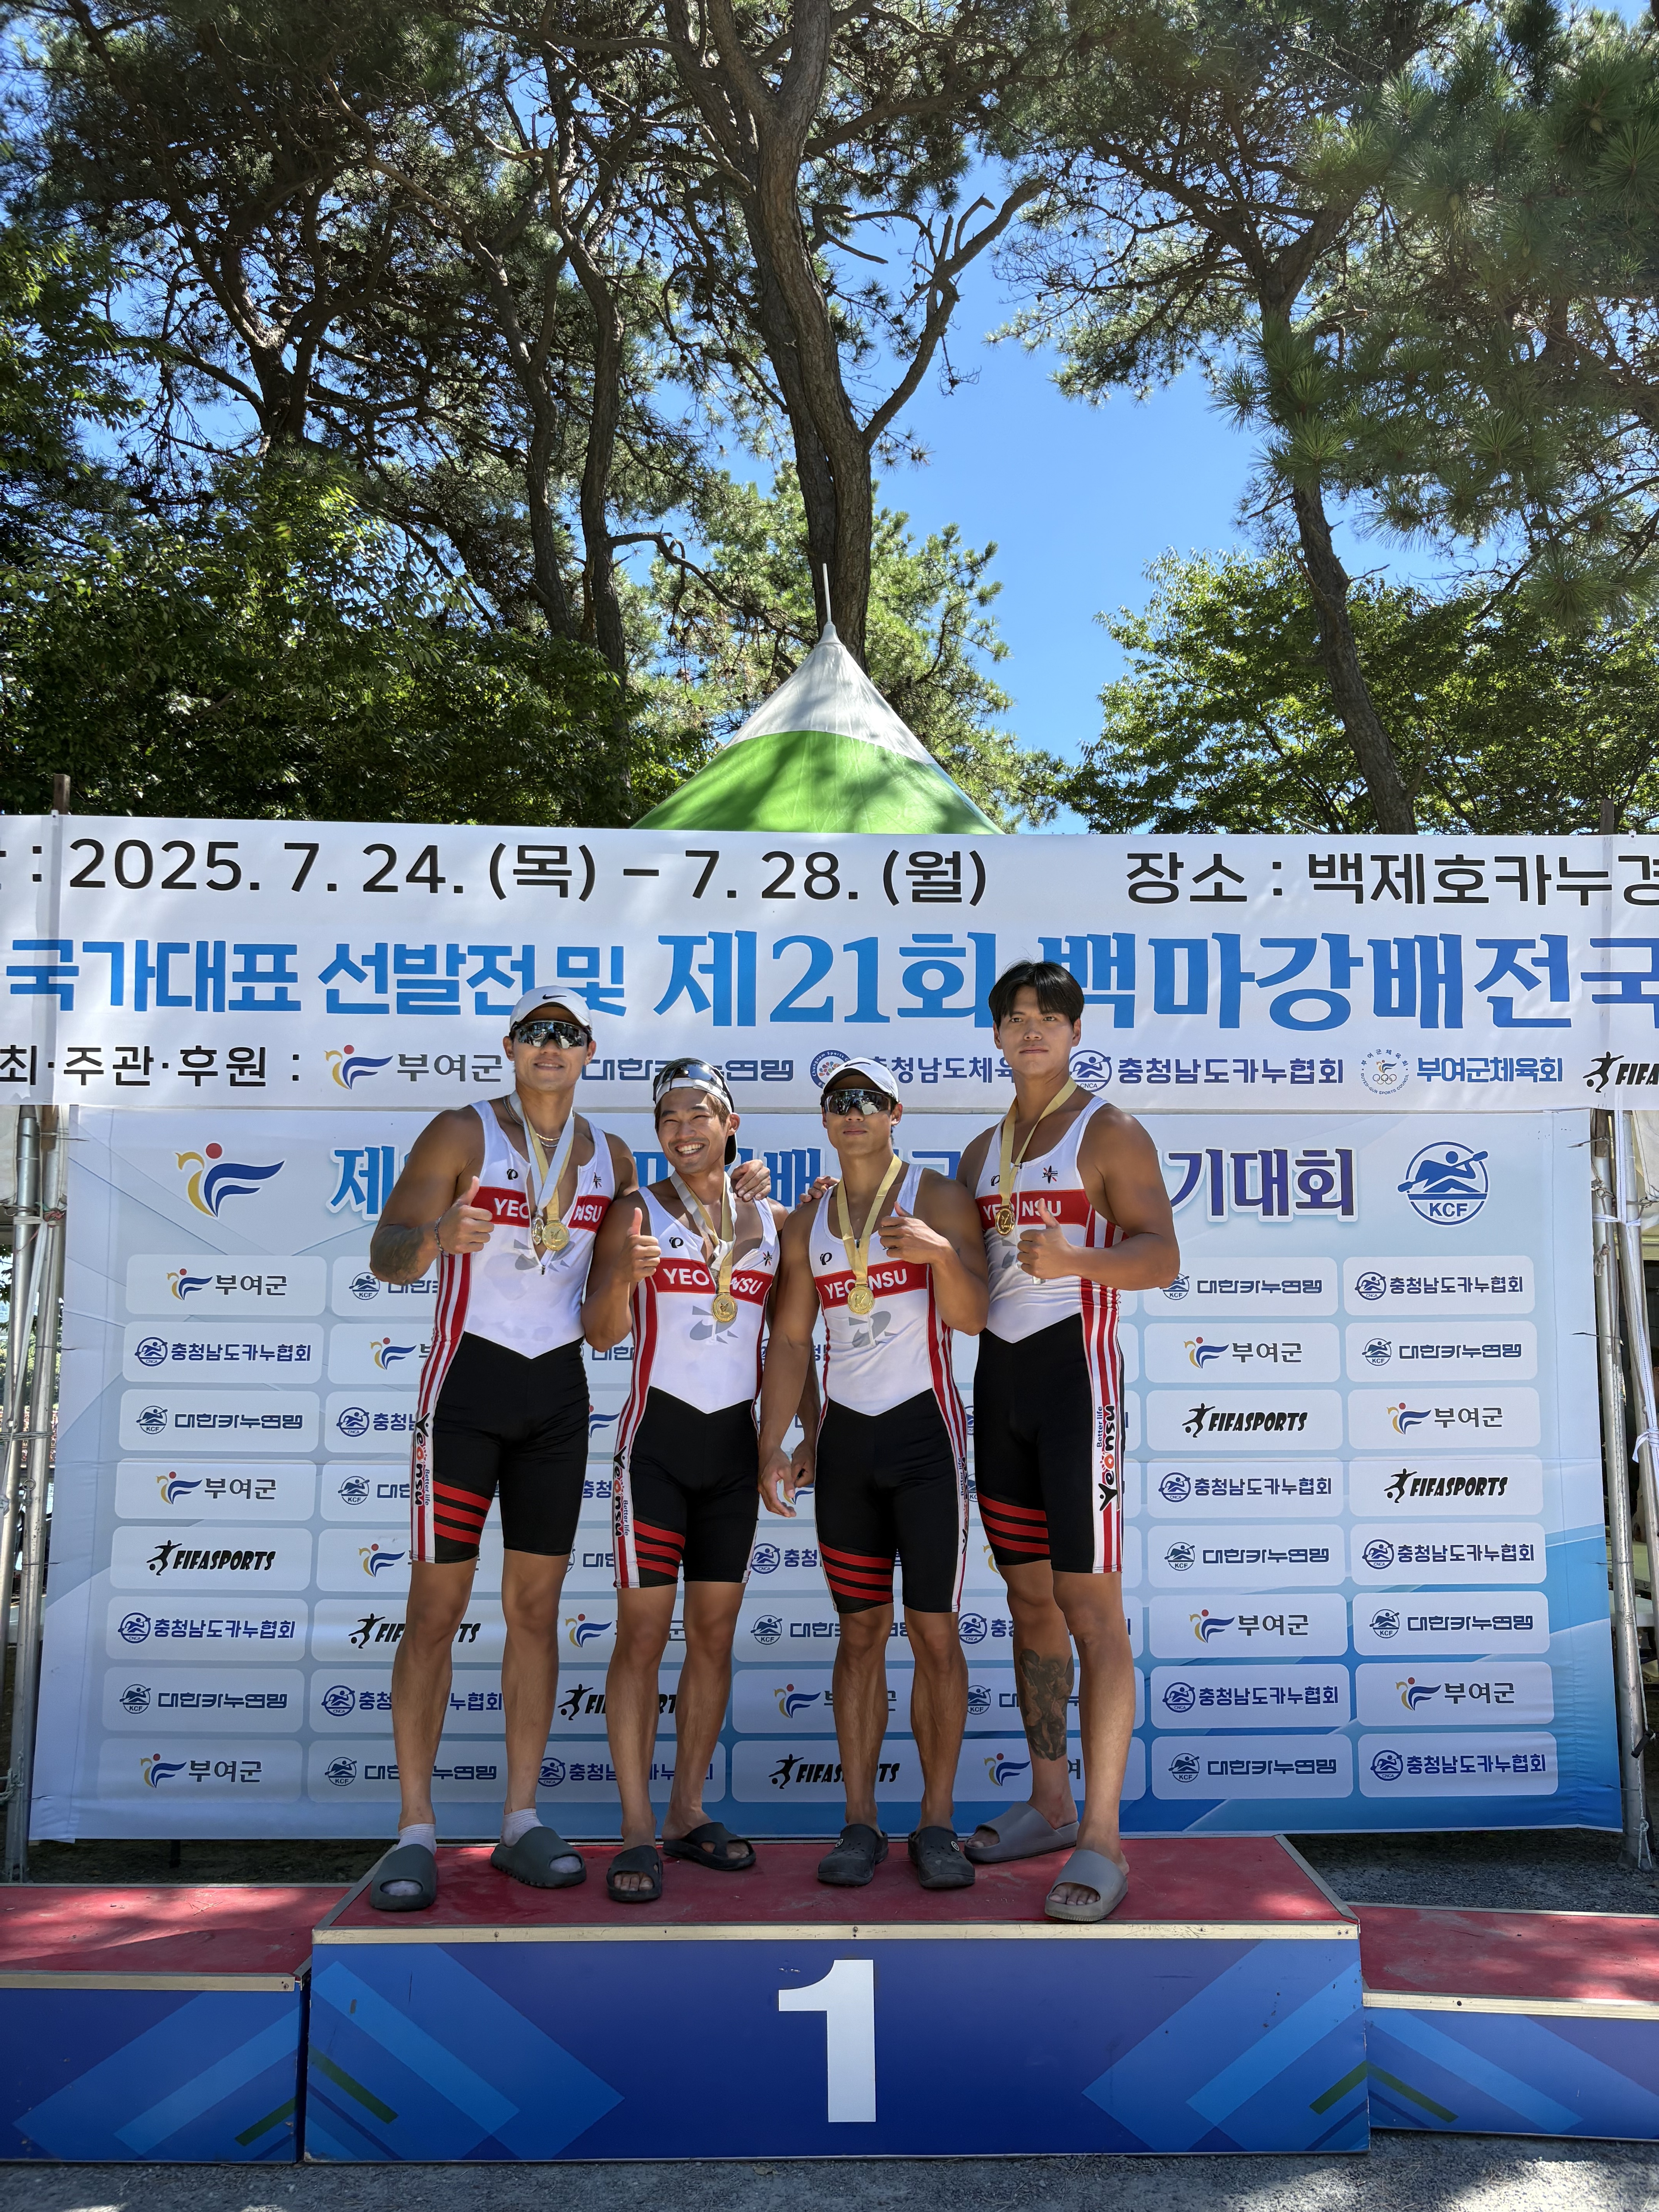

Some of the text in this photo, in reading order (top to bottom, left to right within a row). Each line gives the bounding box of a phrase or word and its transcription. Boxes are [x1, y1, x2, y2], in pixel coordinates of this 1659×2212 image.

[70, 838, 259, 891] 2025.
[284, 842, 337, 892] 7.
[363, 843, 463, 893] 24.
[489, 843, 595, 902] (목)
[685, 850, 737, 899] 7.
[762, 851, 858, 900] 28.
[883, 849, 986, 907] (월)
[1127, 852, 1247, 904] 장소
[6, 939, 301, 1012] 국가대표
[318, 943, 535, 1016] 선발전
[556, 946, 626, 1017] 및
[654, 930, 997, 1029] 제21회
[397, 1054, 503, 1082] 부여군
[1118, 1058, 1343, 1084] 충청남도카누협회
[1417, 1056, 1563, 1083] 부여군체육회
[1429, 1203, 1468, 1217] KCF
[215, 1275, 287, 1296] 부여군
[1197, 1279, 1322, 1294] 대한카누연맹
[1389, 1276, 1523, 1294] 충청남도카누협회
[171, 1343, 311, 1362] 충청남도카누협회
[1232, 1343, 1302, 1363] 부여군
[1399, 1344, 1522, 1359] 대한카누연맹
[175, 1413, 303, 1429] 대한카누연맹
[1208, 1412, 1308, 1432] FIFASPORTS
[1434, 1408, 1503, 1428] 부여군
[204, 1478, 276, 1500] 부여군
[1194, 1477, 1331, 1496] 충청남도카누협회
[1410, 1476, 1508, 1496] FIFASPORTS
[173, 1551, 276, 1571] FIFASPORTS
[1203, 1548, 1329, 1564] 대한카누연맹
[1398, 1544, 1534, 1563] 충청남도카누협회
[154, 1618, 295, 1639] 충청남도카누협회
[1238, 1614, 1309, 1636] 부여군
[1407, 1615, 1533, 1631] 대한카누연맹
[158, 1692, 287, 1709] 대한카누연맹
[1199, 1686, 1338, 1706] 충청남도카누협회
[1444, 1683, 1515, 1704] 부여군
[189, 1760, 262, 1783] 부여군
[1207, 1759, 1336, 1775] 대한카누연맹
[1407, 1753, 1546, 1774] 충청남도카누협회
[779, 1960, 876, 2122] 1
